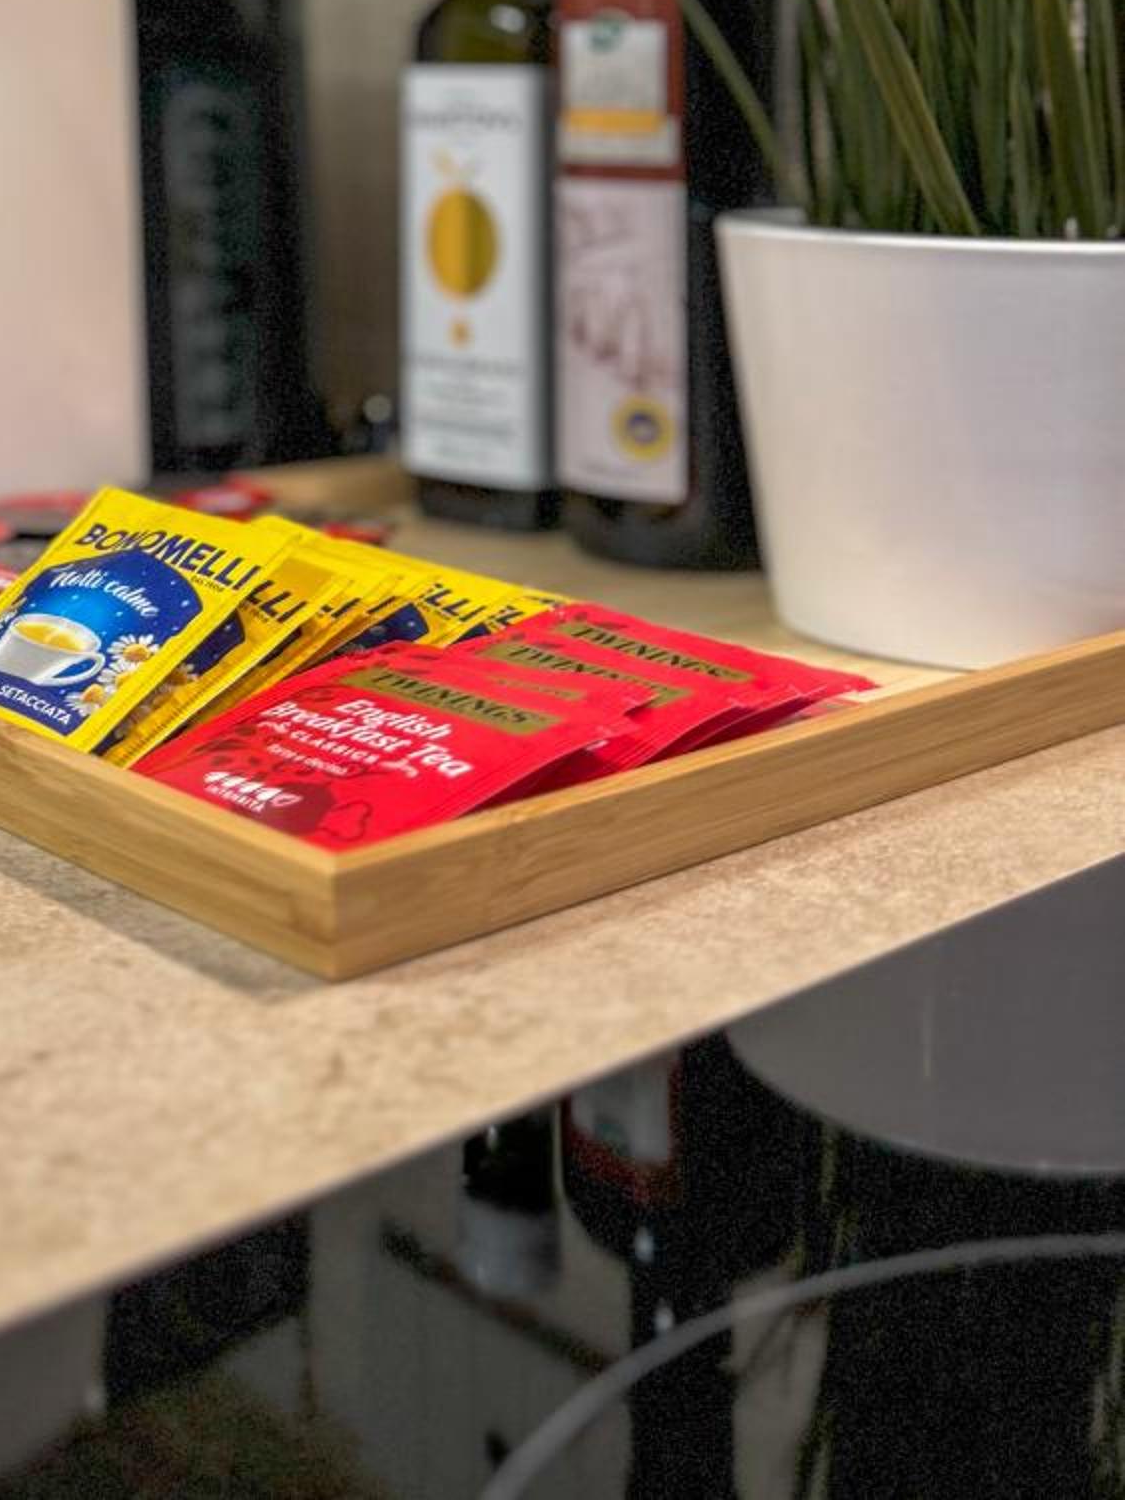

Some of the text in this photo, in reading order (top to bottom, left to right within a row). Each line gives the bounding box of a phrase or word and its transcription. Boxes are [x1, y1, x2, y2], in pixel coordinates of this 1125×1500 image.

[75, 523, 261, 591] BONOMELLI
[103, 580, 159, 617] calme
[572, 627, 722, 677] TWININGS
[332, 699, 453, 740] English
[372, 672, 535, 724] TWININGS
[259, 701, 474, 778] Breakfast Tea
